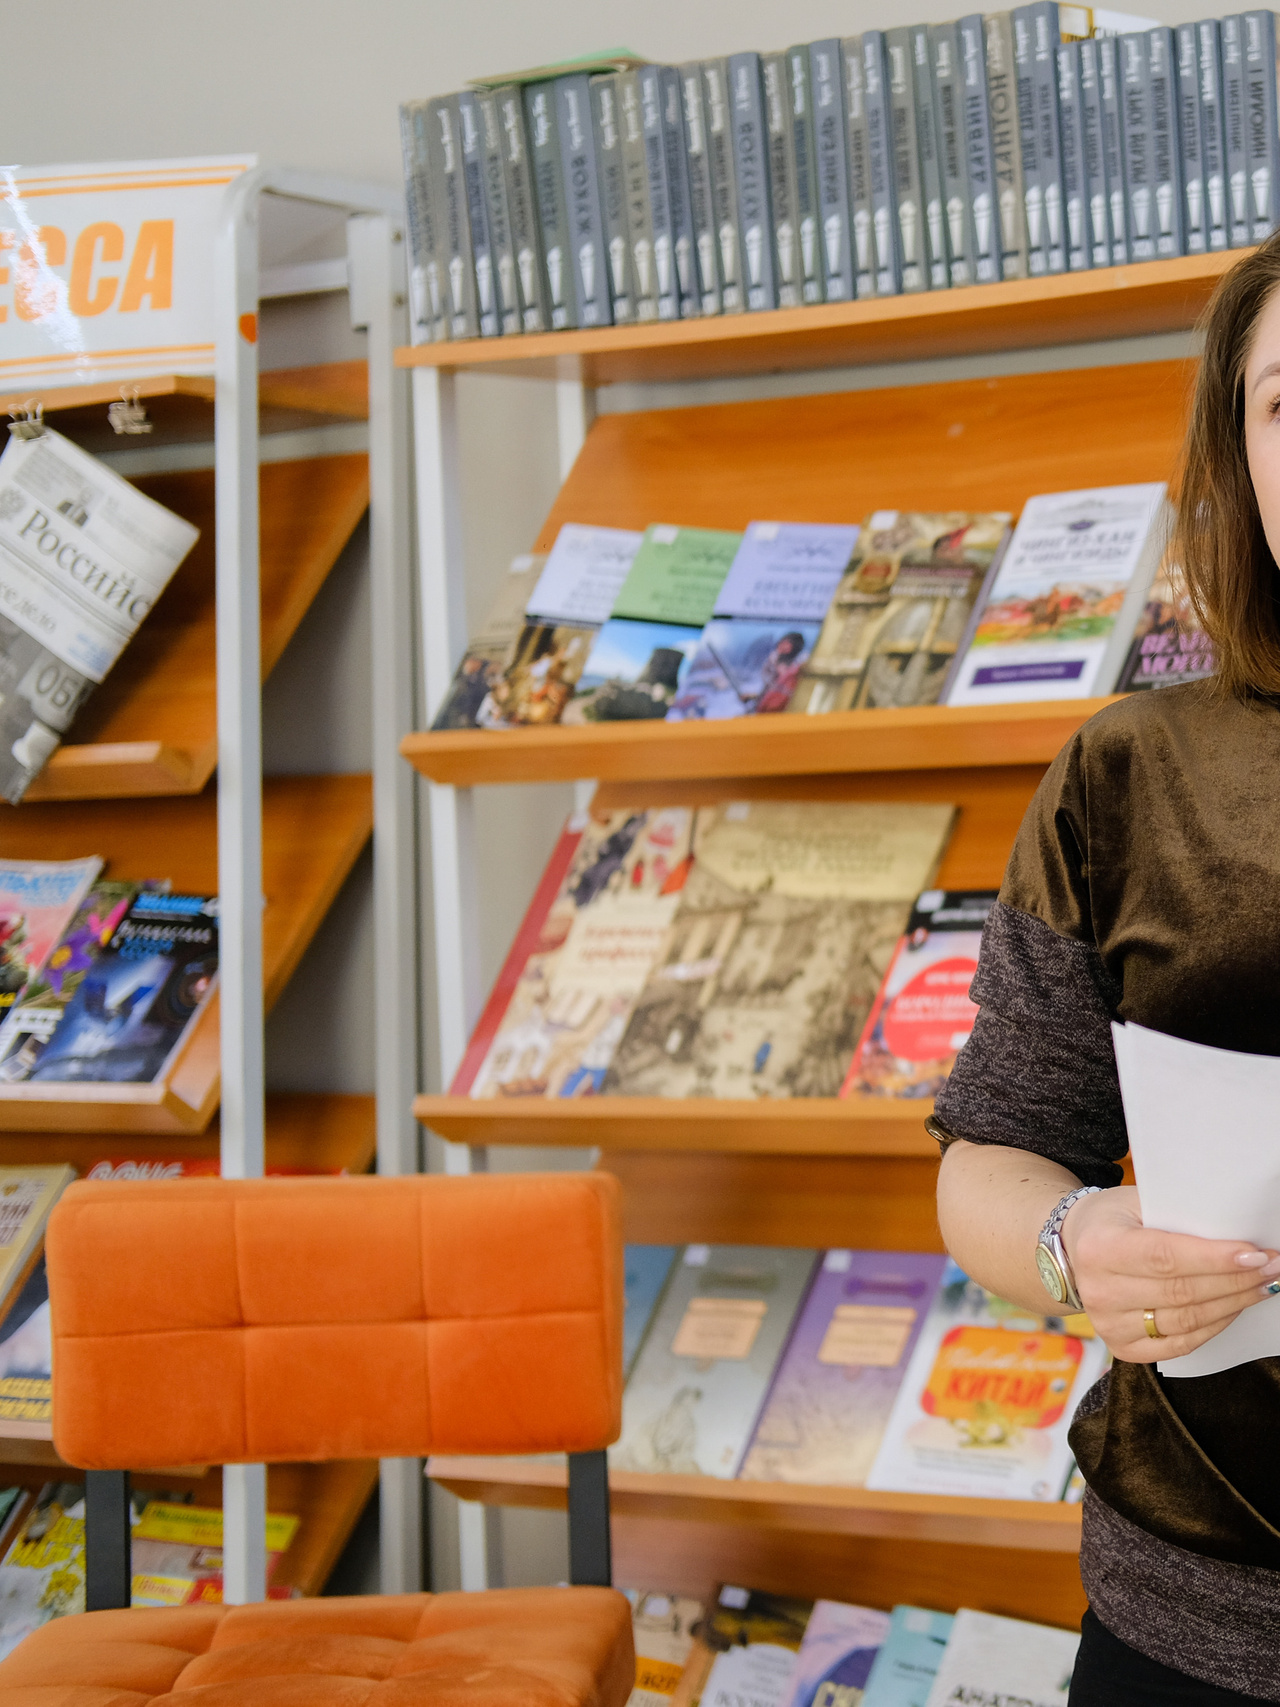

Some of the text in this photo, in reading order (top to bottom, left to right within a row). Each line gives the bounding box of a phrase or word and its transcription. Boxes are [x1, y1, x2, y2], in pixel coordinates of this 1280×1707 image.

[966, 93, 987, 184] ДАРВИН
[988, 73, 1015, 186] ДАНТОН
[1126, 87, 1147, 184] РИХАРД ЗОРГЕ
[1182, 94, 1199, 162] МЕЦЕНАТ
[1249, 80, 1268, 159] НИКОЛАЙ
